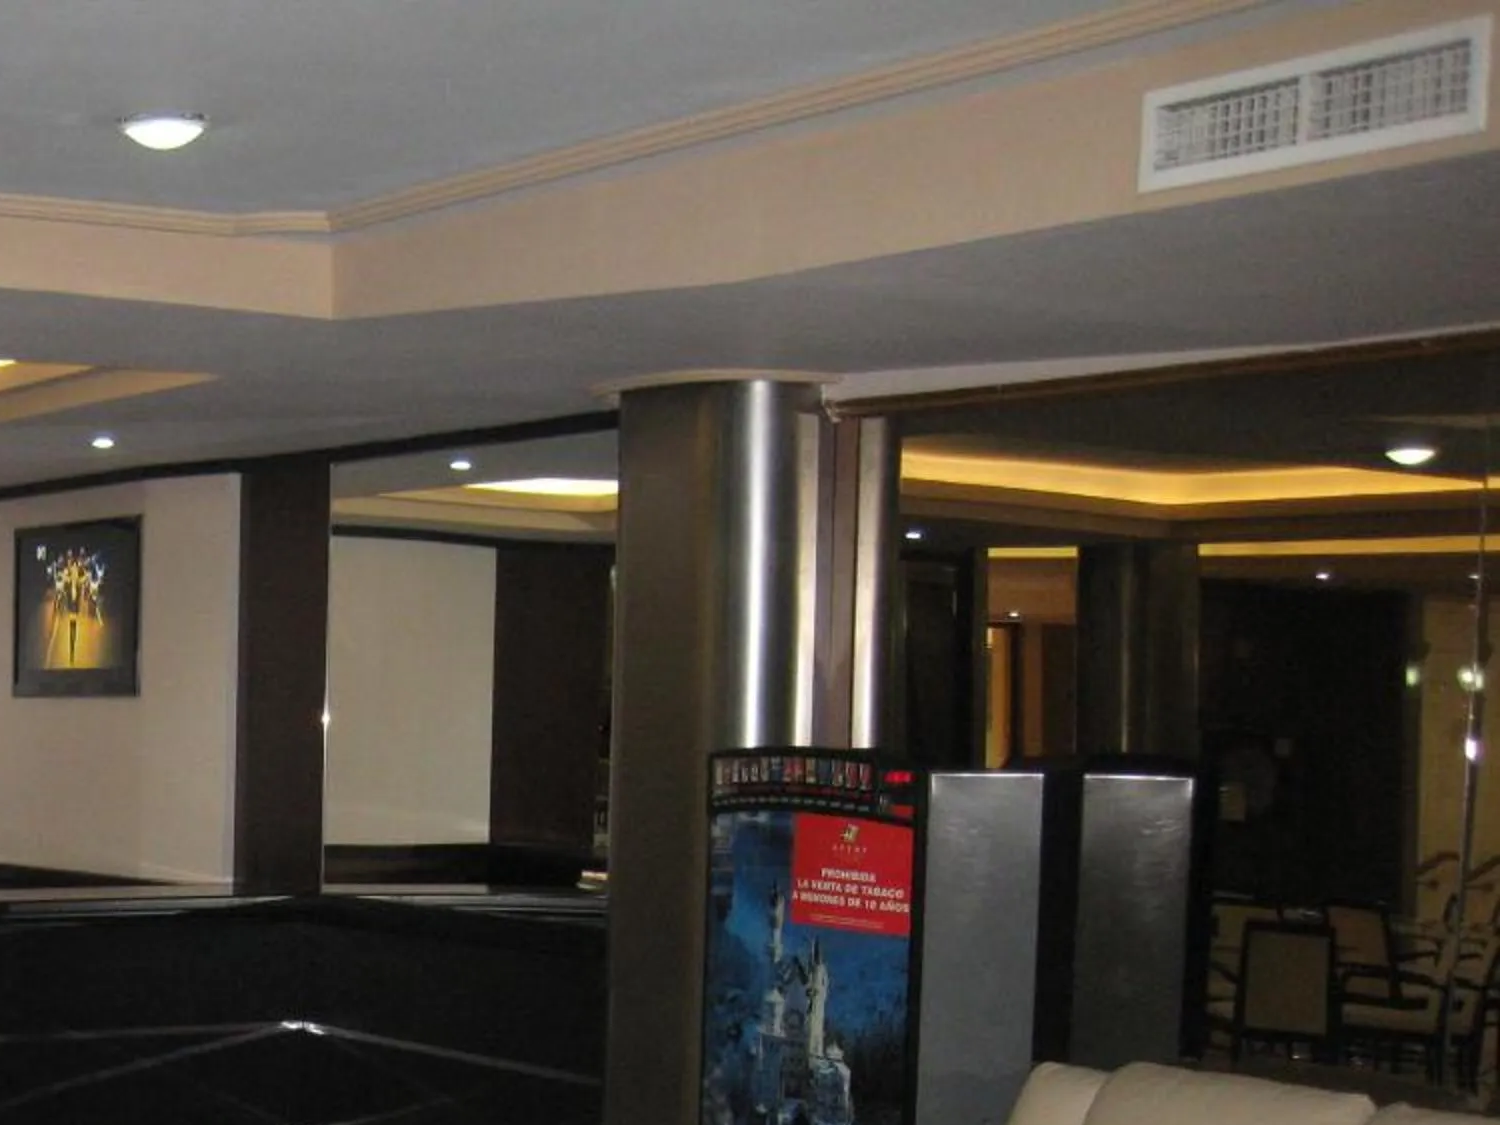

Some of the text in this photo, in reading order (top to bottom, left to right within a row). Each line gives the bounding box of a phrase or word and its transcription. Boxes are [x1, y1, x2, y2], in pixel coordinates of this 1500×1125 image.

[797, 879, 904, 899] LA VENTA DE TABACO
[847, 897, 861, 907] DE
